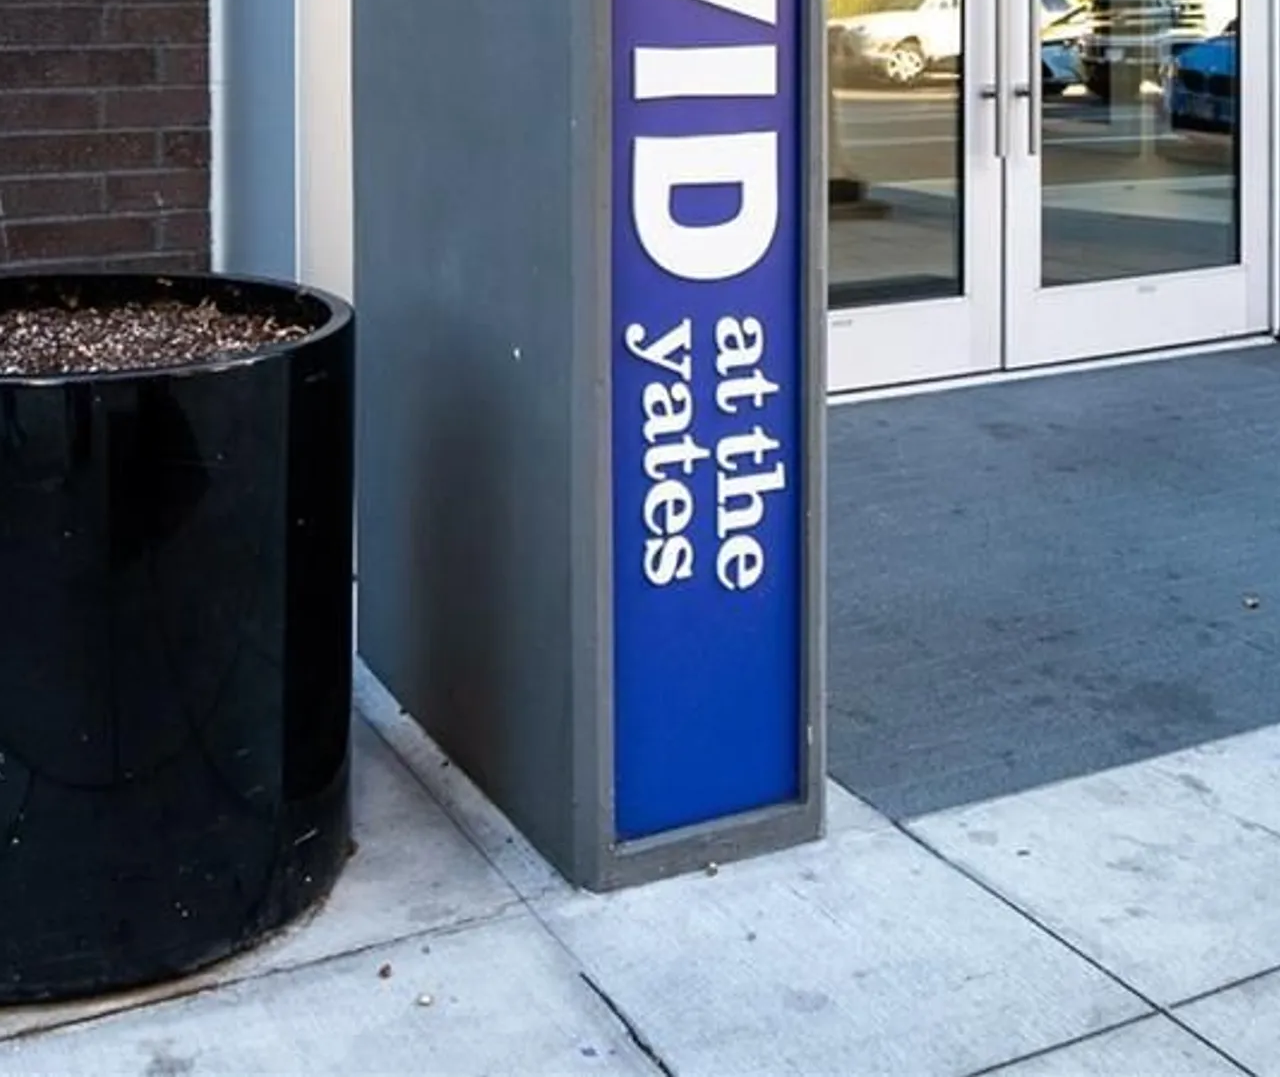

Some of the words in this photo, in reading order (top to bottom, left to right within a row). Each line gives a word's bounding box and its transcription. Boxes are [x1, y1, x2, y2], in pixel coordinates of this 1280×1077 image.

[715, 316, 780, 414] at
[625, 318, 711, 586] yates
[716, 426, 786, 591] the
